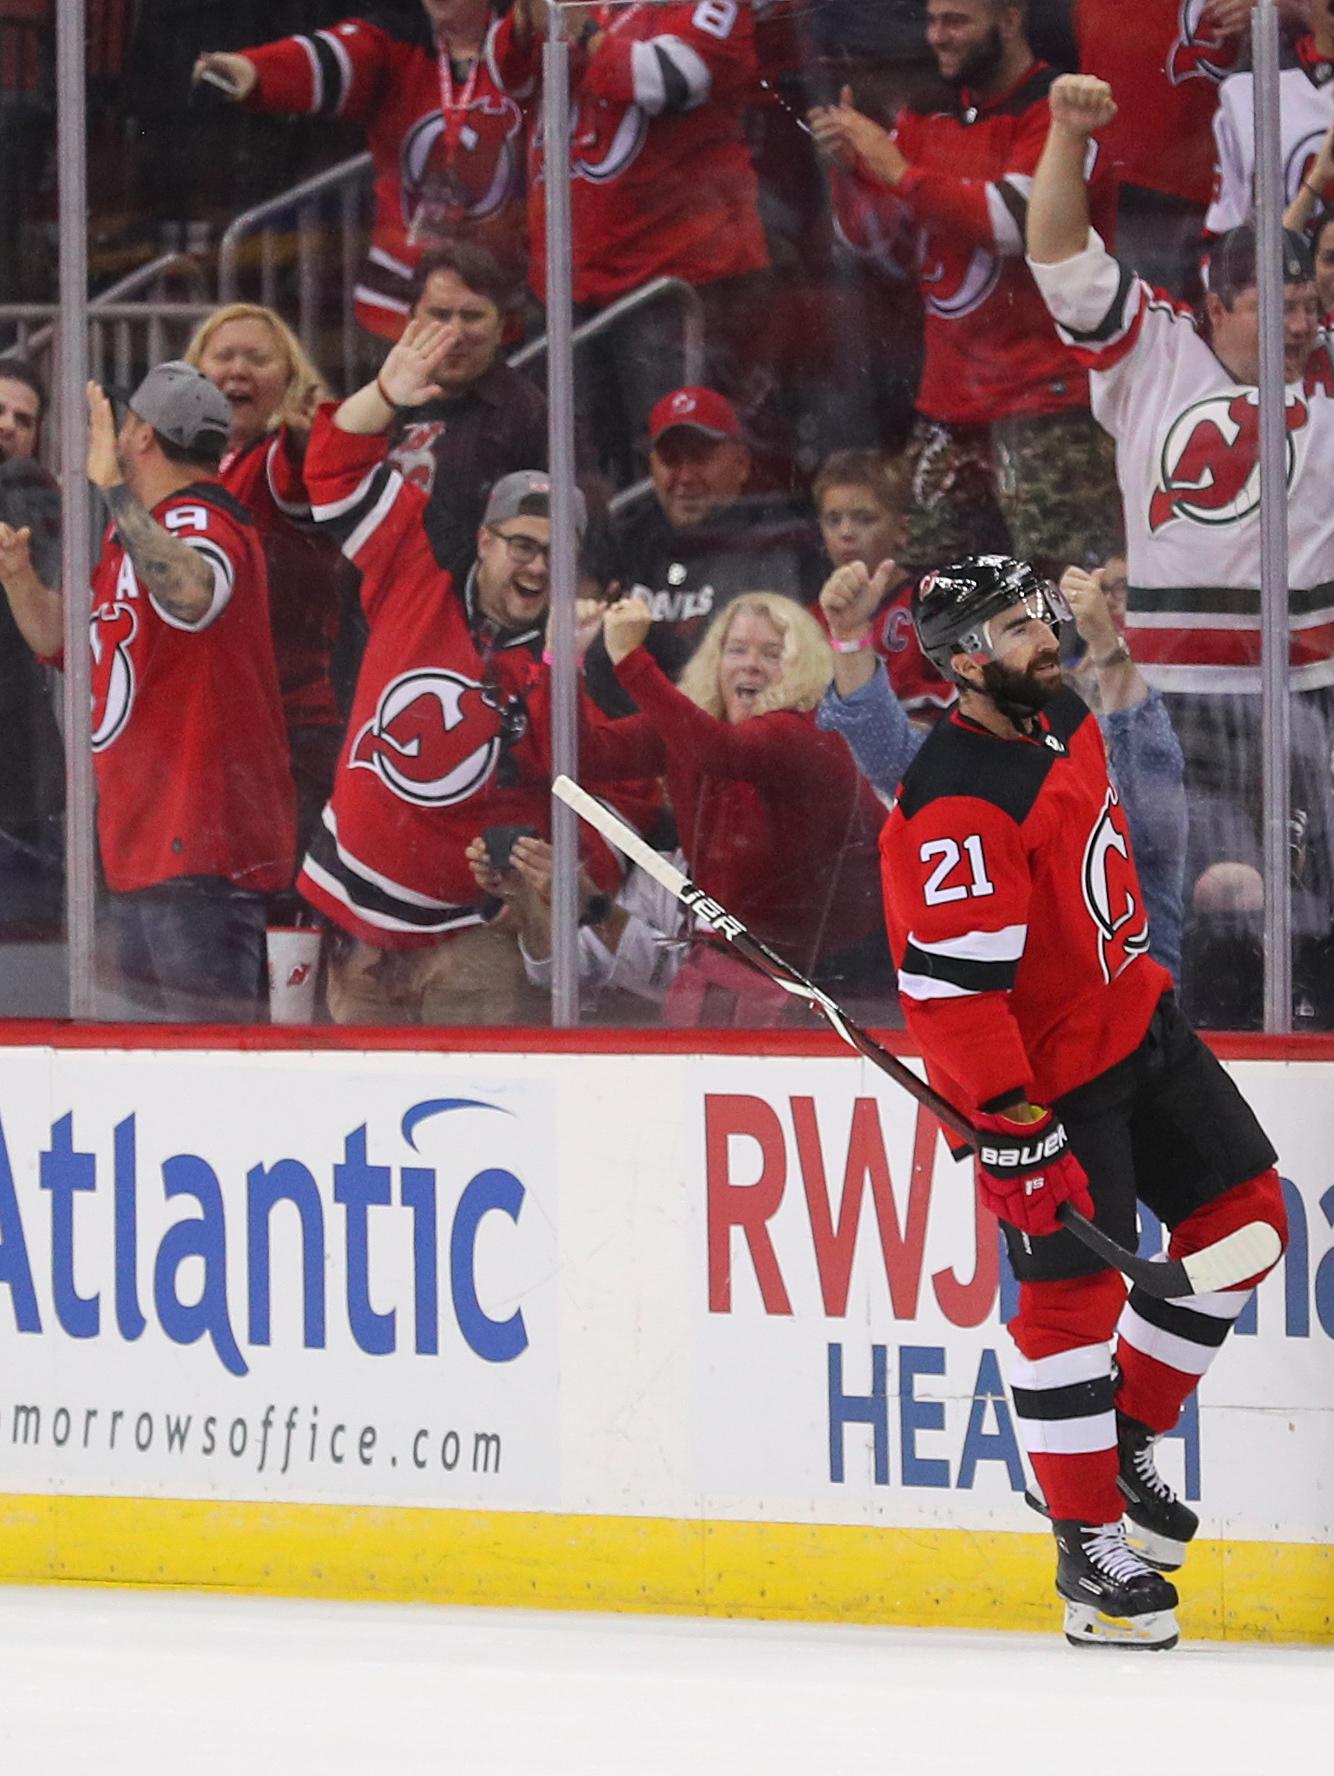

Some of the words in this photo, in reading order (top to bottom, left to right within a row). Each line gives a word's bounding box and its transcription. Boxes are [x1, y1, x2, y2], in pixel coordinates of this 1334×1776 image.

[116, 552, 139, 600] A
[919, 833, 995, 907] 21
[981, 1123, 1068, 1167] BAUER
